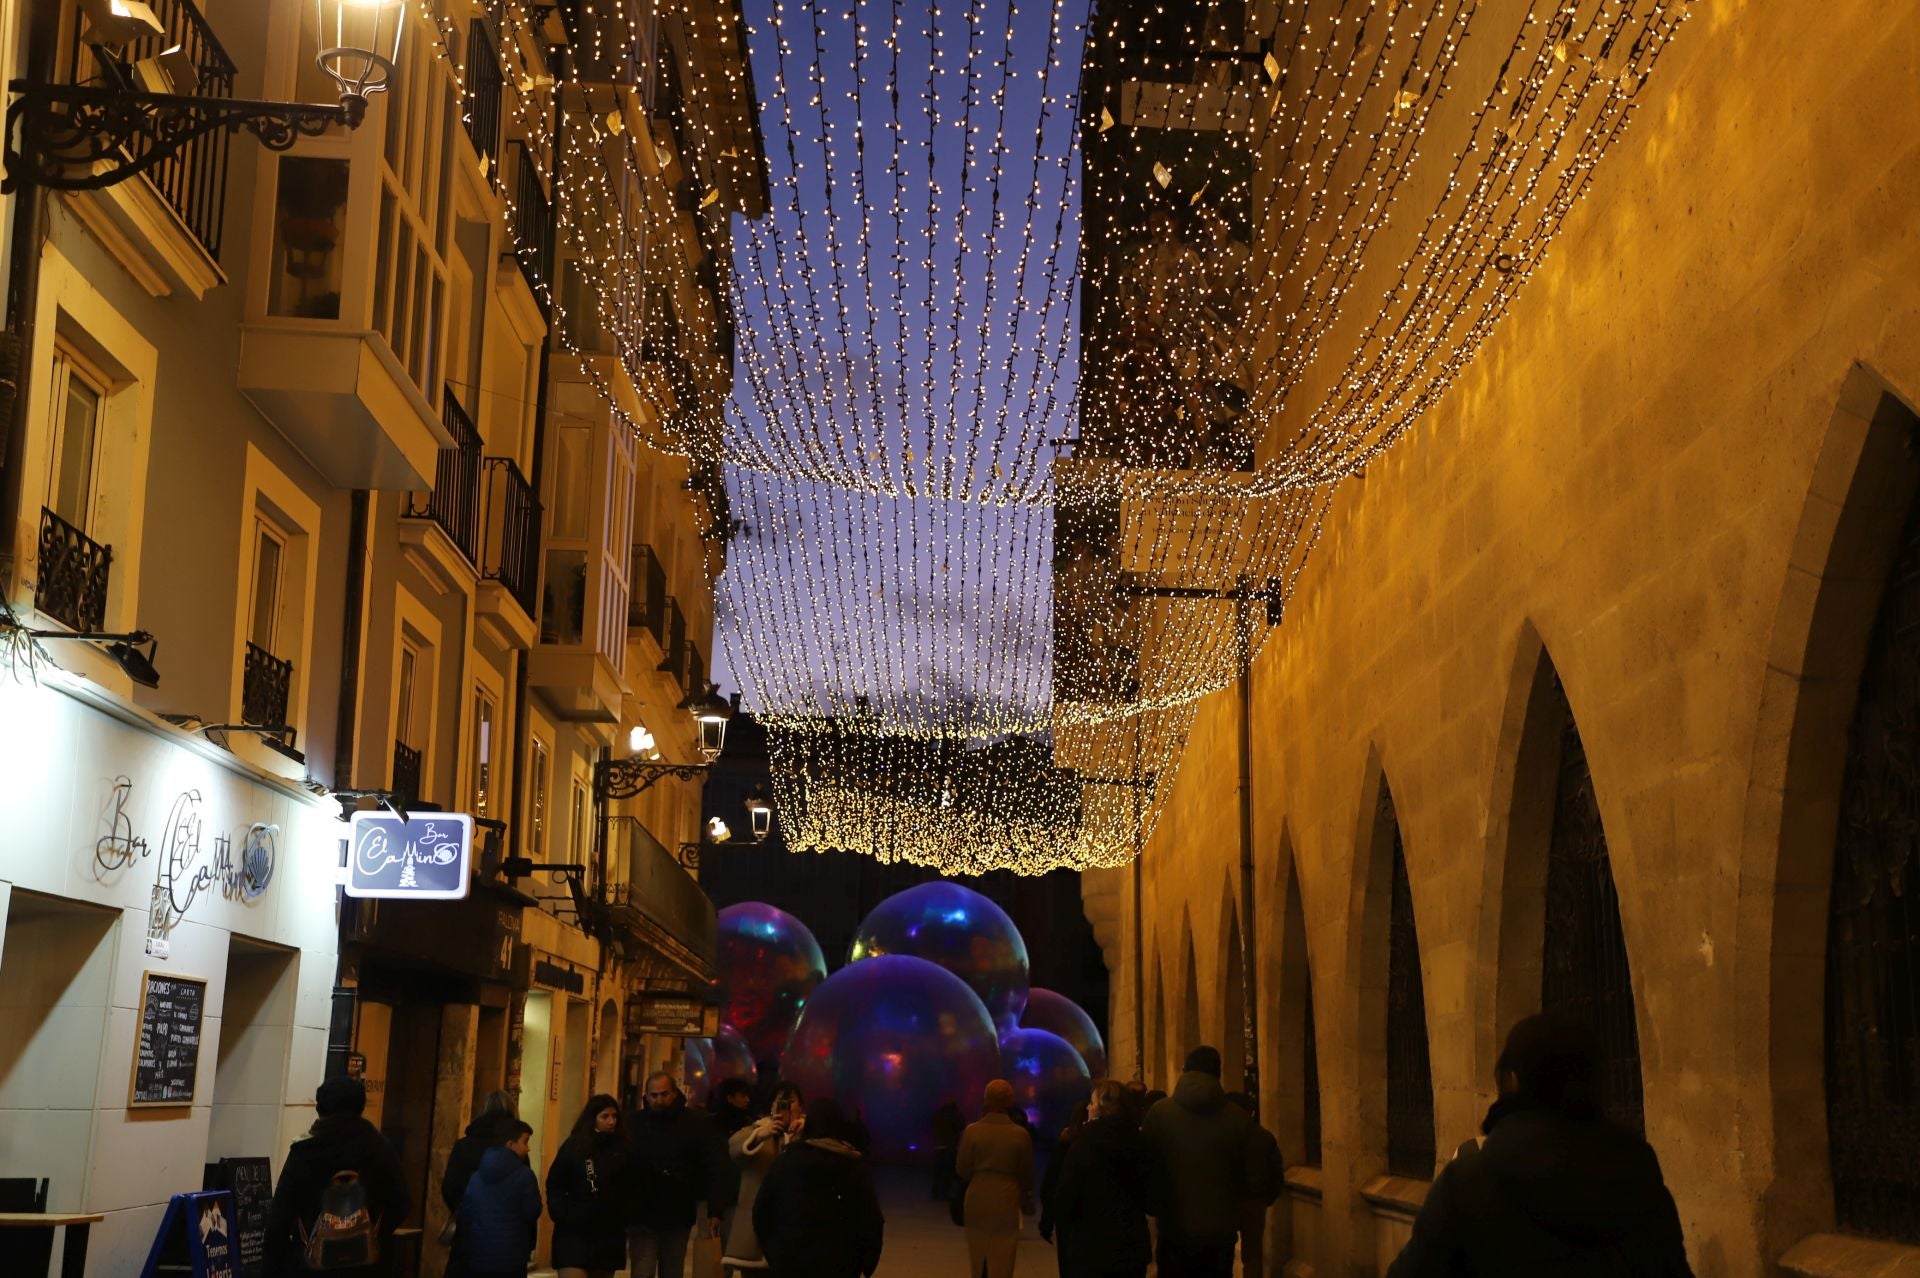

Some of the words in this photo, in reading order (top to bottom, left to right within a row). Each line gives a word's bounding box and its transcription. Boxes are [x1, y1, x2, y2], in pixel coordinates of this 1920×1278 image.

[97, 775, 151, 870] Bar
[420, 822, 448, 845] Bar
[366, 835, 388, 859] El
[500, 935, 513, 970] 41
[156, 1022, 169, 1036] PULPO
[206, 1244, 228, 1259] Tenemos
